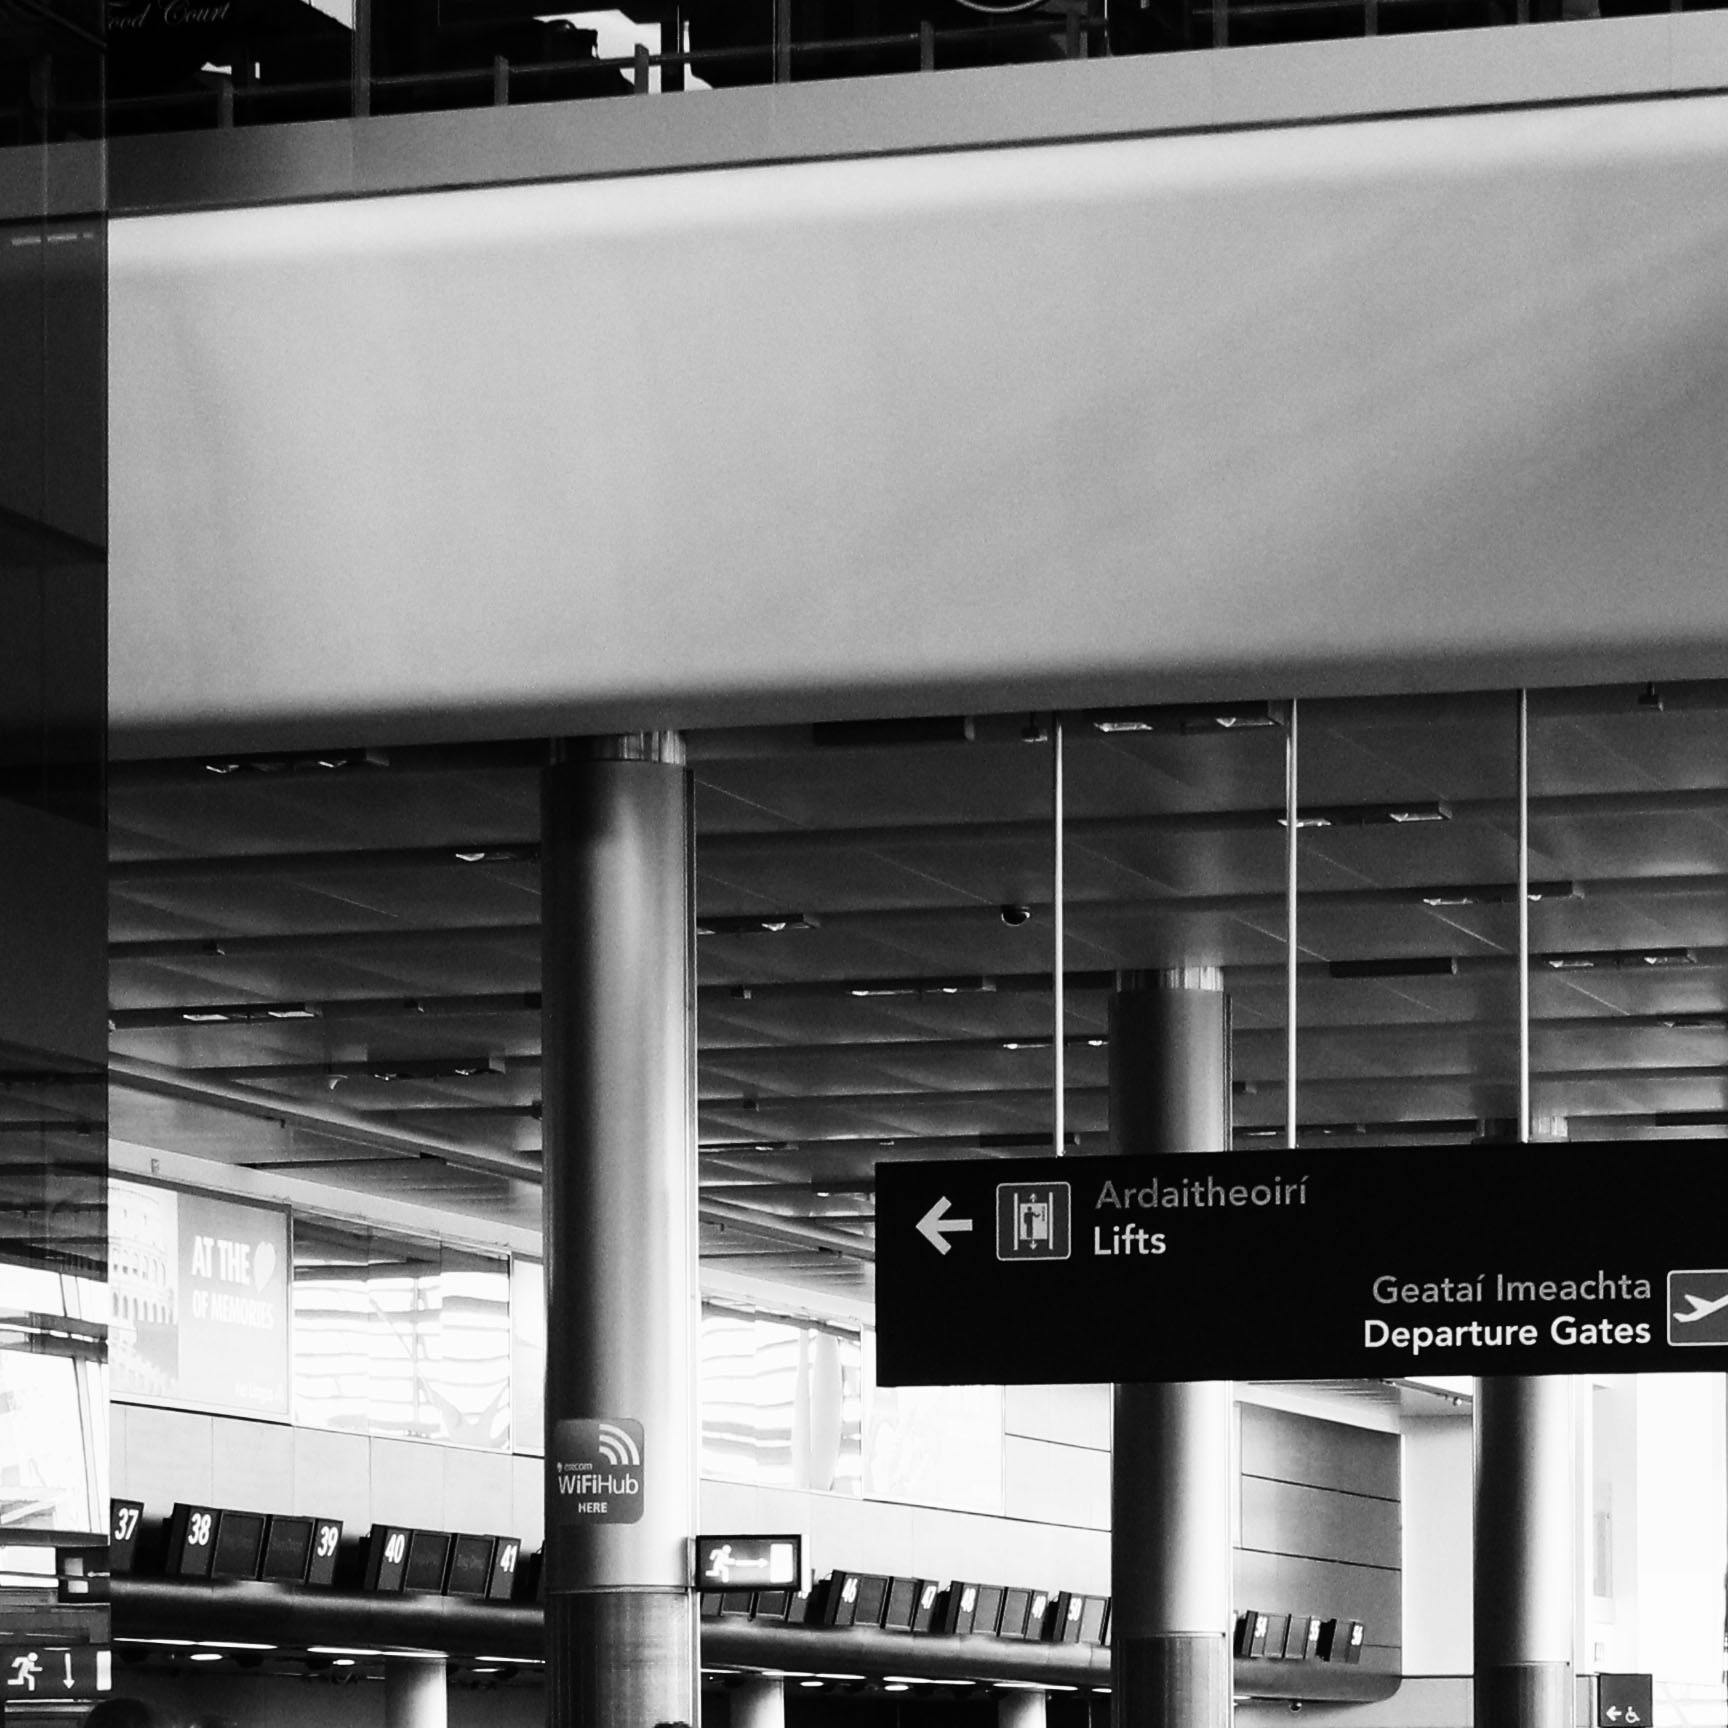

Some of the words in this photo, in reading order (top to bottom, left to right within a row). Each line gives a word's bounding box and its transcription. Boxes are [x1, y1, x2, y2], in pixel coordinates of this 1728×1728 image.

[1095, 1176, 1309, 1210] Ardaitheoirí
[1093, 1223, 1167, 1256] Lifts
[192, 1235, 215, 1279] AT
[218, 1240, 251, 1286] THE
[1373, 1271, 1485, 1305] Geataí
[1496, 1269, 1652, 1303] Imeachta
[192, 1290, 209, 1320] OF
[1364, 1319, 1539, 1356] Departure
[1549, 1316, 1652, 1347] Gates
[558, 1473, 640, 1495] WiFiHub
[578, 1502, 608, 1513] HERE
[115, 1508, 139, 1541] 37
[188, 1512, 213, 1546] 38
[317, 1526, 339, 1558] 39
[384, 1532, 405, 1564] 40
[501, 1544, 517, 1573] 41
